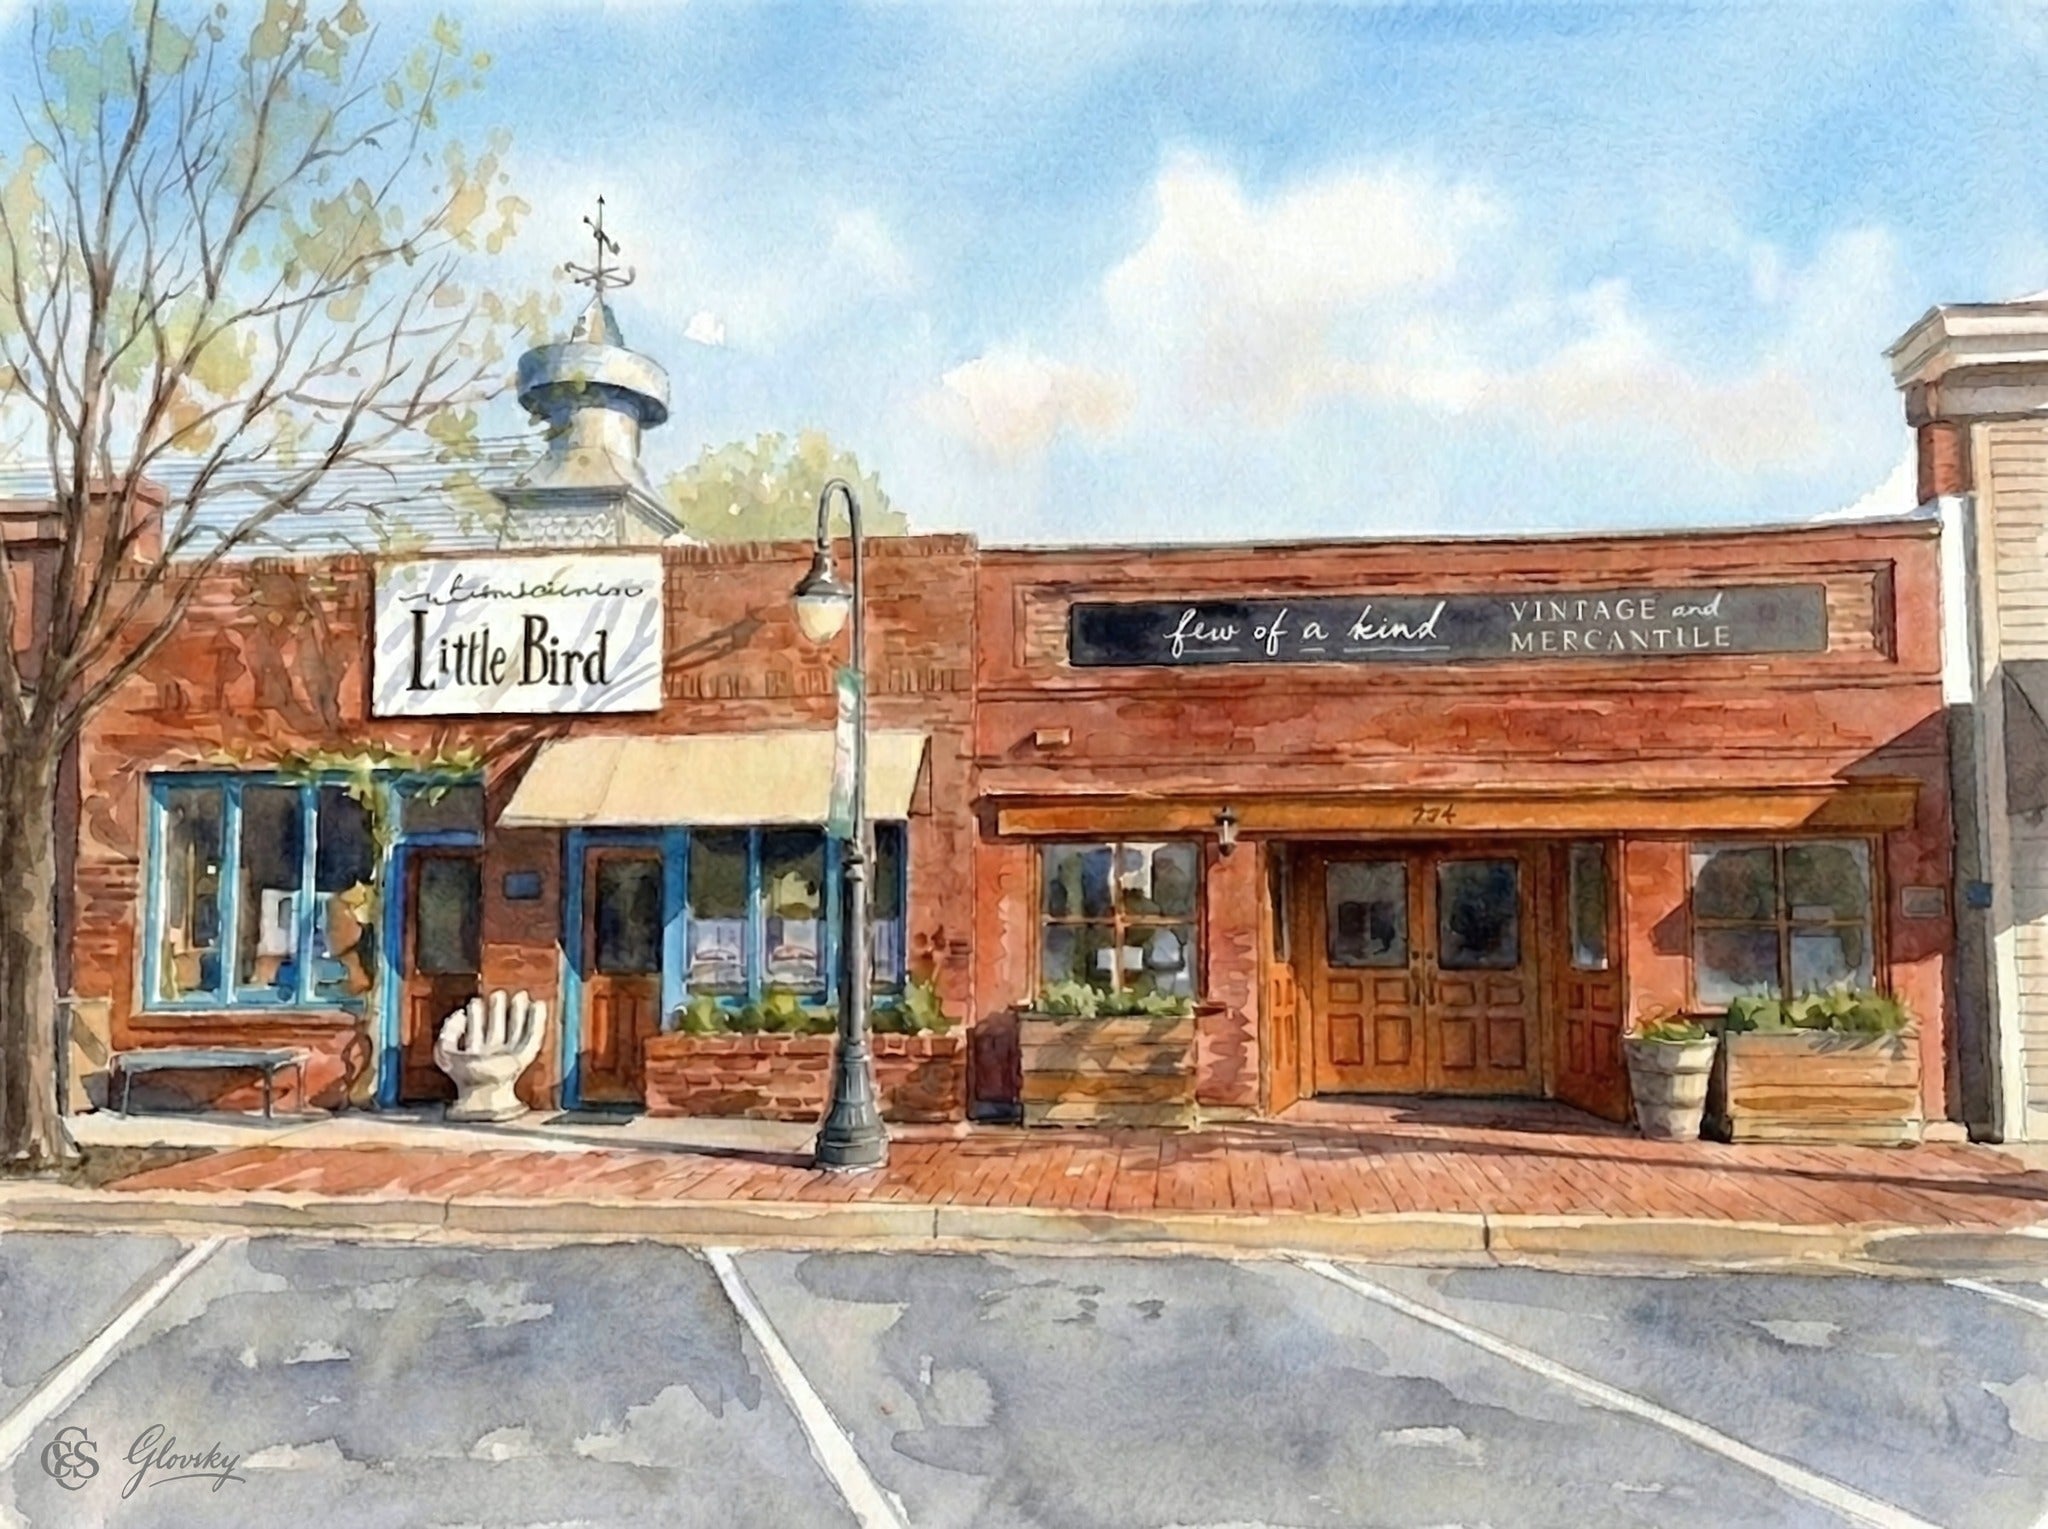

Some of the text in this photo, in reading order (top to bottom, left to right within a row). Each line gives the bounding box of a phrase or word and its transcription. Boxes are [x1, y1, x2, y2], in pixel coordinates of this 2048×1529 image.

[1163, 600, 1446, 658] few of a kind
[1510, 593, 1723, 622] VINTAGE and
[406, 609, 609, 691] Little Bird
[1510, 626, 1731, 652] MERCANTILE
